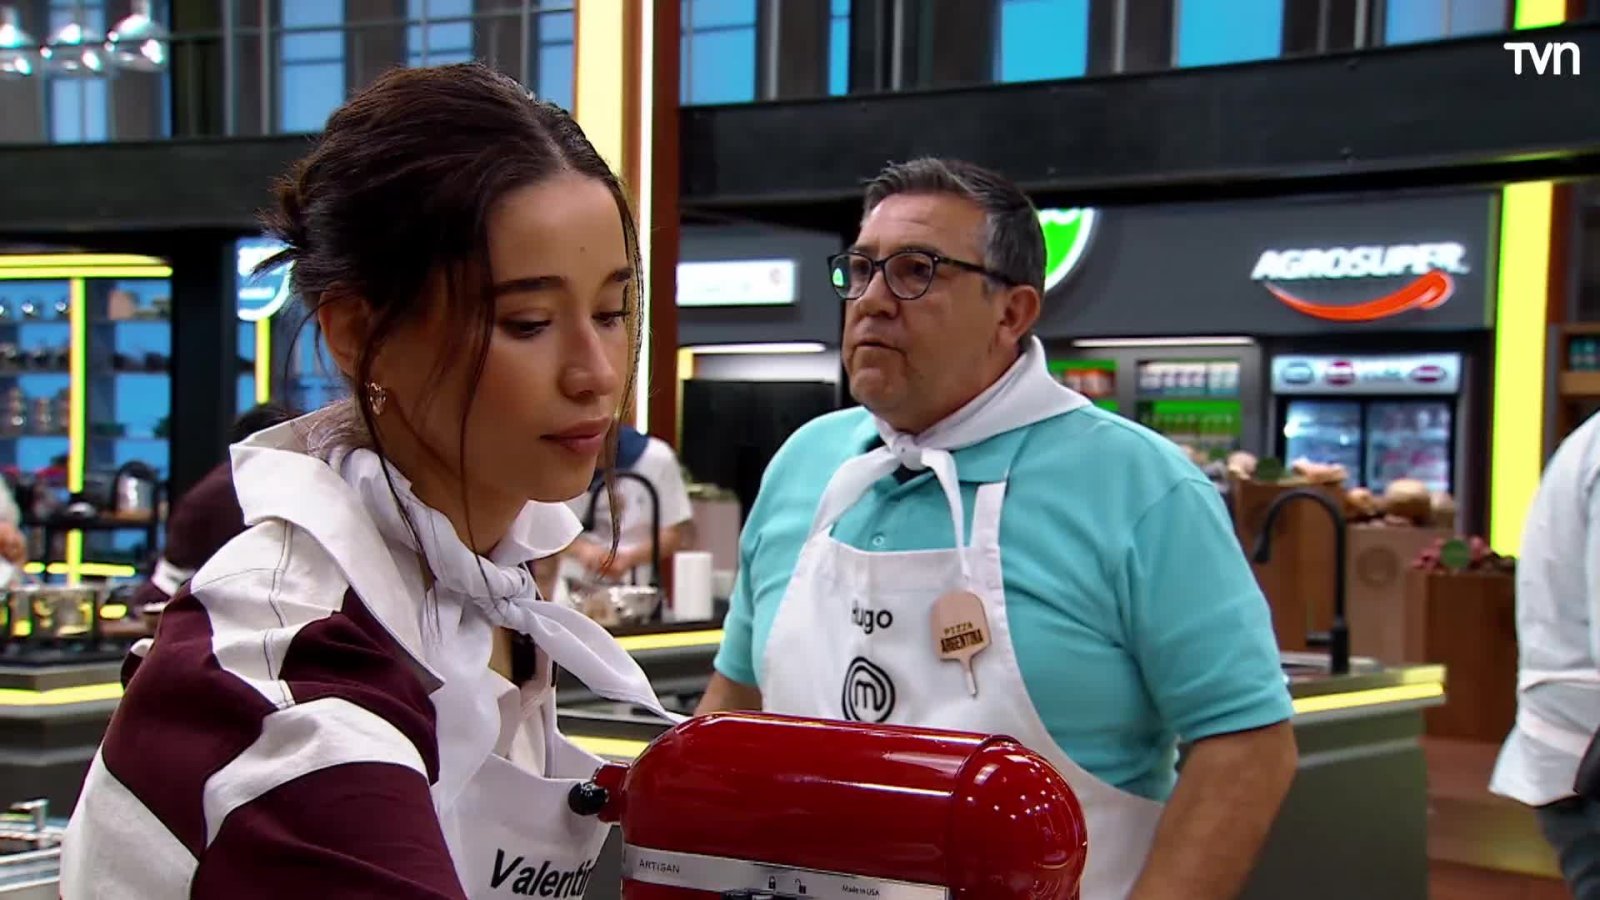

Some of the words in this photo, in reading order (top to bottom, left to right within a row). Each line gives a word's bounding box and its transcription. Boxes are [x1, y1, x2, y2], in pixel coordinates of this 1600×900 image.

[1250, 242, 1469, 280] AGROSUPER
[639, 858, 680, 874] ARTISAN
[842, 884, 859, 895] Made
[866, 888, 880, 896] USA
